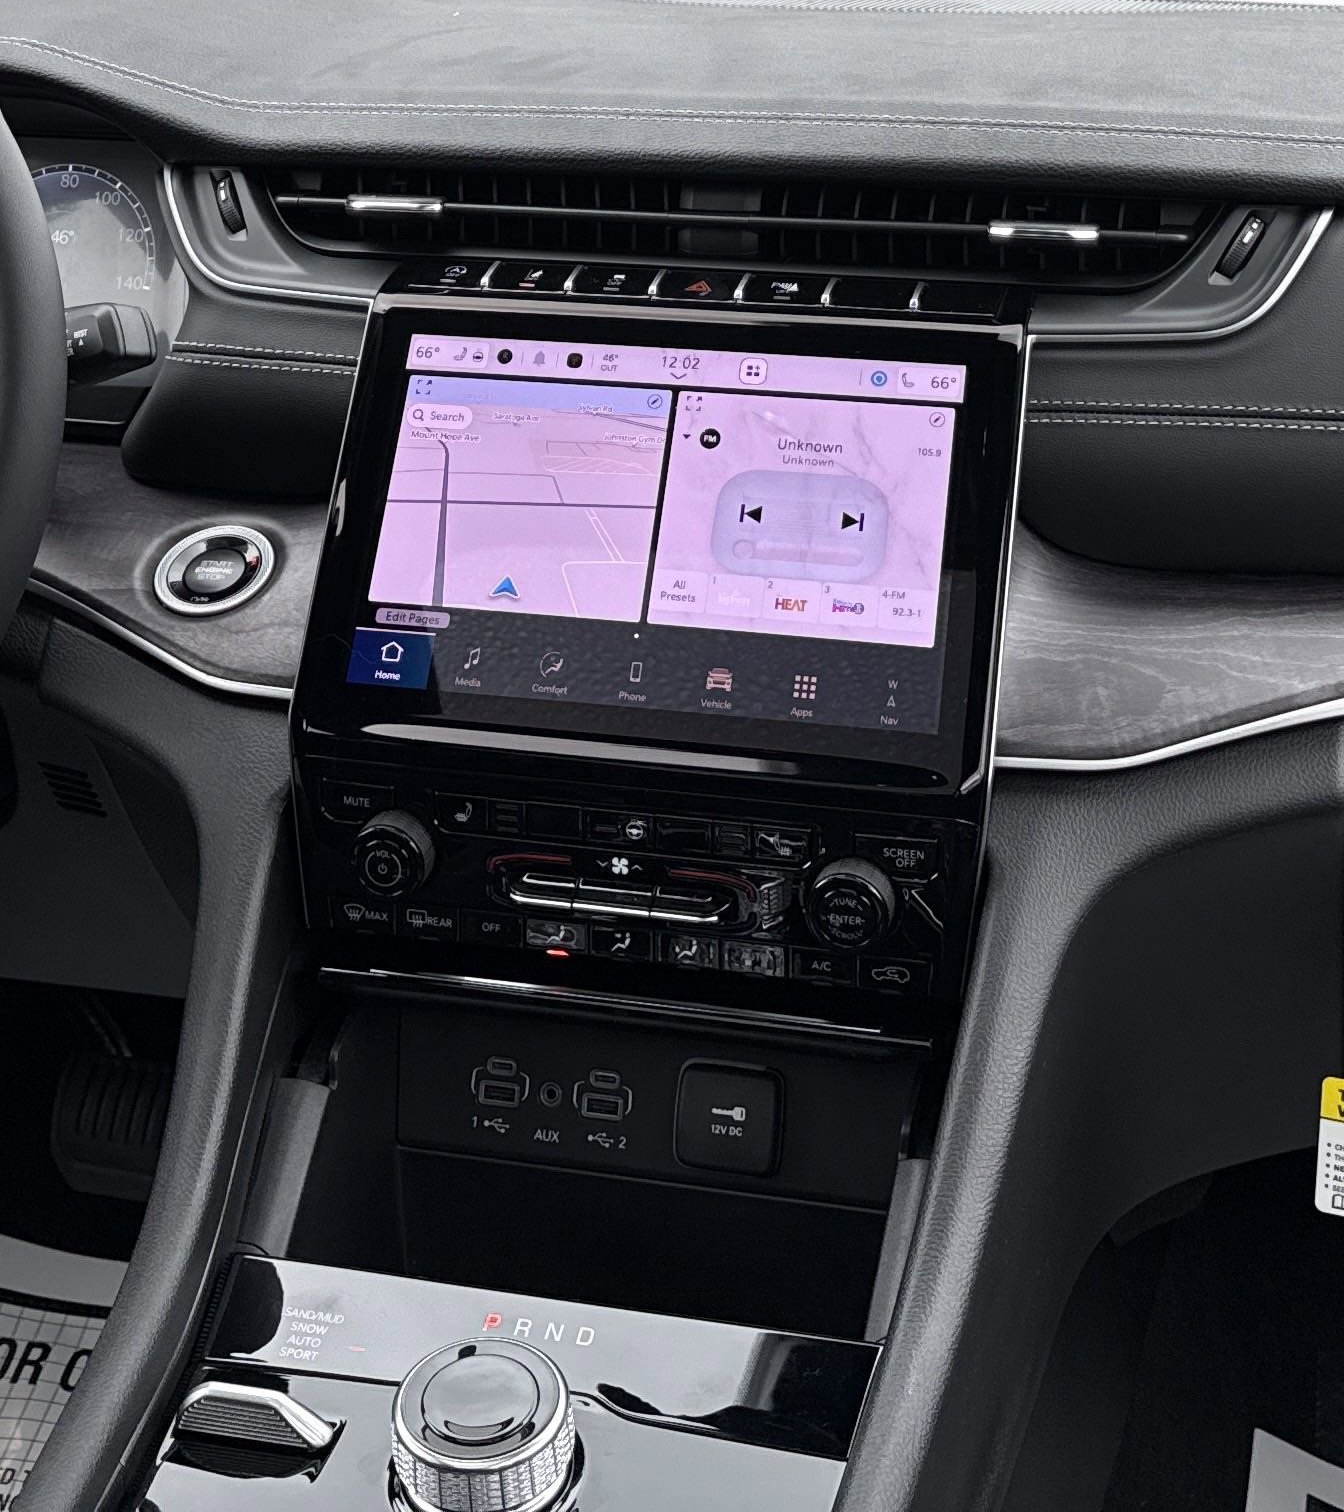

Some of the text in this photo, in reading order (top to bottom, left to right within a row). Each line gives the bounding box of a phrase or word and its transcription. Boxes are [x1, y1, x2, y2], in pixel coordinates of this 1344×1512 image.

[60, 174, 79, 188] 80
[93, 191, 120, 205] 100
[117, 228, 143, 242] 120
[114, 276, 142, 290] 140
[416, 346, 440, 359] 66°
[601, 365, 617, 373] OUT
[931, 376, 956, 389] 66°
[430, 411, 465, 423] Search
[411, 431, 439, 440] Mount
[441, 433, 463, 442] Hope
[703, 434, 718, 443] FM
[777, 438, 843, 454] Unknown
[917, 447, 942, 457] 105.9
[782, 454, 834, 468] Unknown
[673, 579, 686, 590] All
[660, 591, 696, 604] Presets
[882, 590, 906, 600] 4-FM
[775, 597, 808, 612] HEAT
[385, 611, 440, 626] Edit Pages
[374, 670, 401, 681] Home
[455, 677, 481, 688] Media
[531, 683, 568, 696] Comfort
[618, 691, 646, 702] Phone
[700, 698, 732, 710] Vehicle
[790, 707, 813, 719] Apps
[880, 715, 899, 726] Nav
[343, 795, 370, 808] MUTE
[375, 849, 391, 859] VOL
[883, 848, 925, 860] SCREEN
[895, 858, 917, 868] OFF
[365, 909, 389, 922] MAX
[427, 916, 452, 928] REAR
[830, 913, 862, 926] ENTER
[481, 922, 501, 933] OFF
[811, 960, 831, 972] A/C
[471, 1116, 478, 1128] 1
[534, 1128, 560, 1144] AUX
[711, 1124, 743, 1137] 12V DC
[618, 1136, 627, 1149] 2
[284, 1306, 345, 1325] SAND/MUD
[291, 1321, 329, 1336] SNOW
[482, 1313, 595, 1347] P R N D
[287, 1335, 321, 1348] AUTO
[279, 1346, 320, 1361] SPORT
